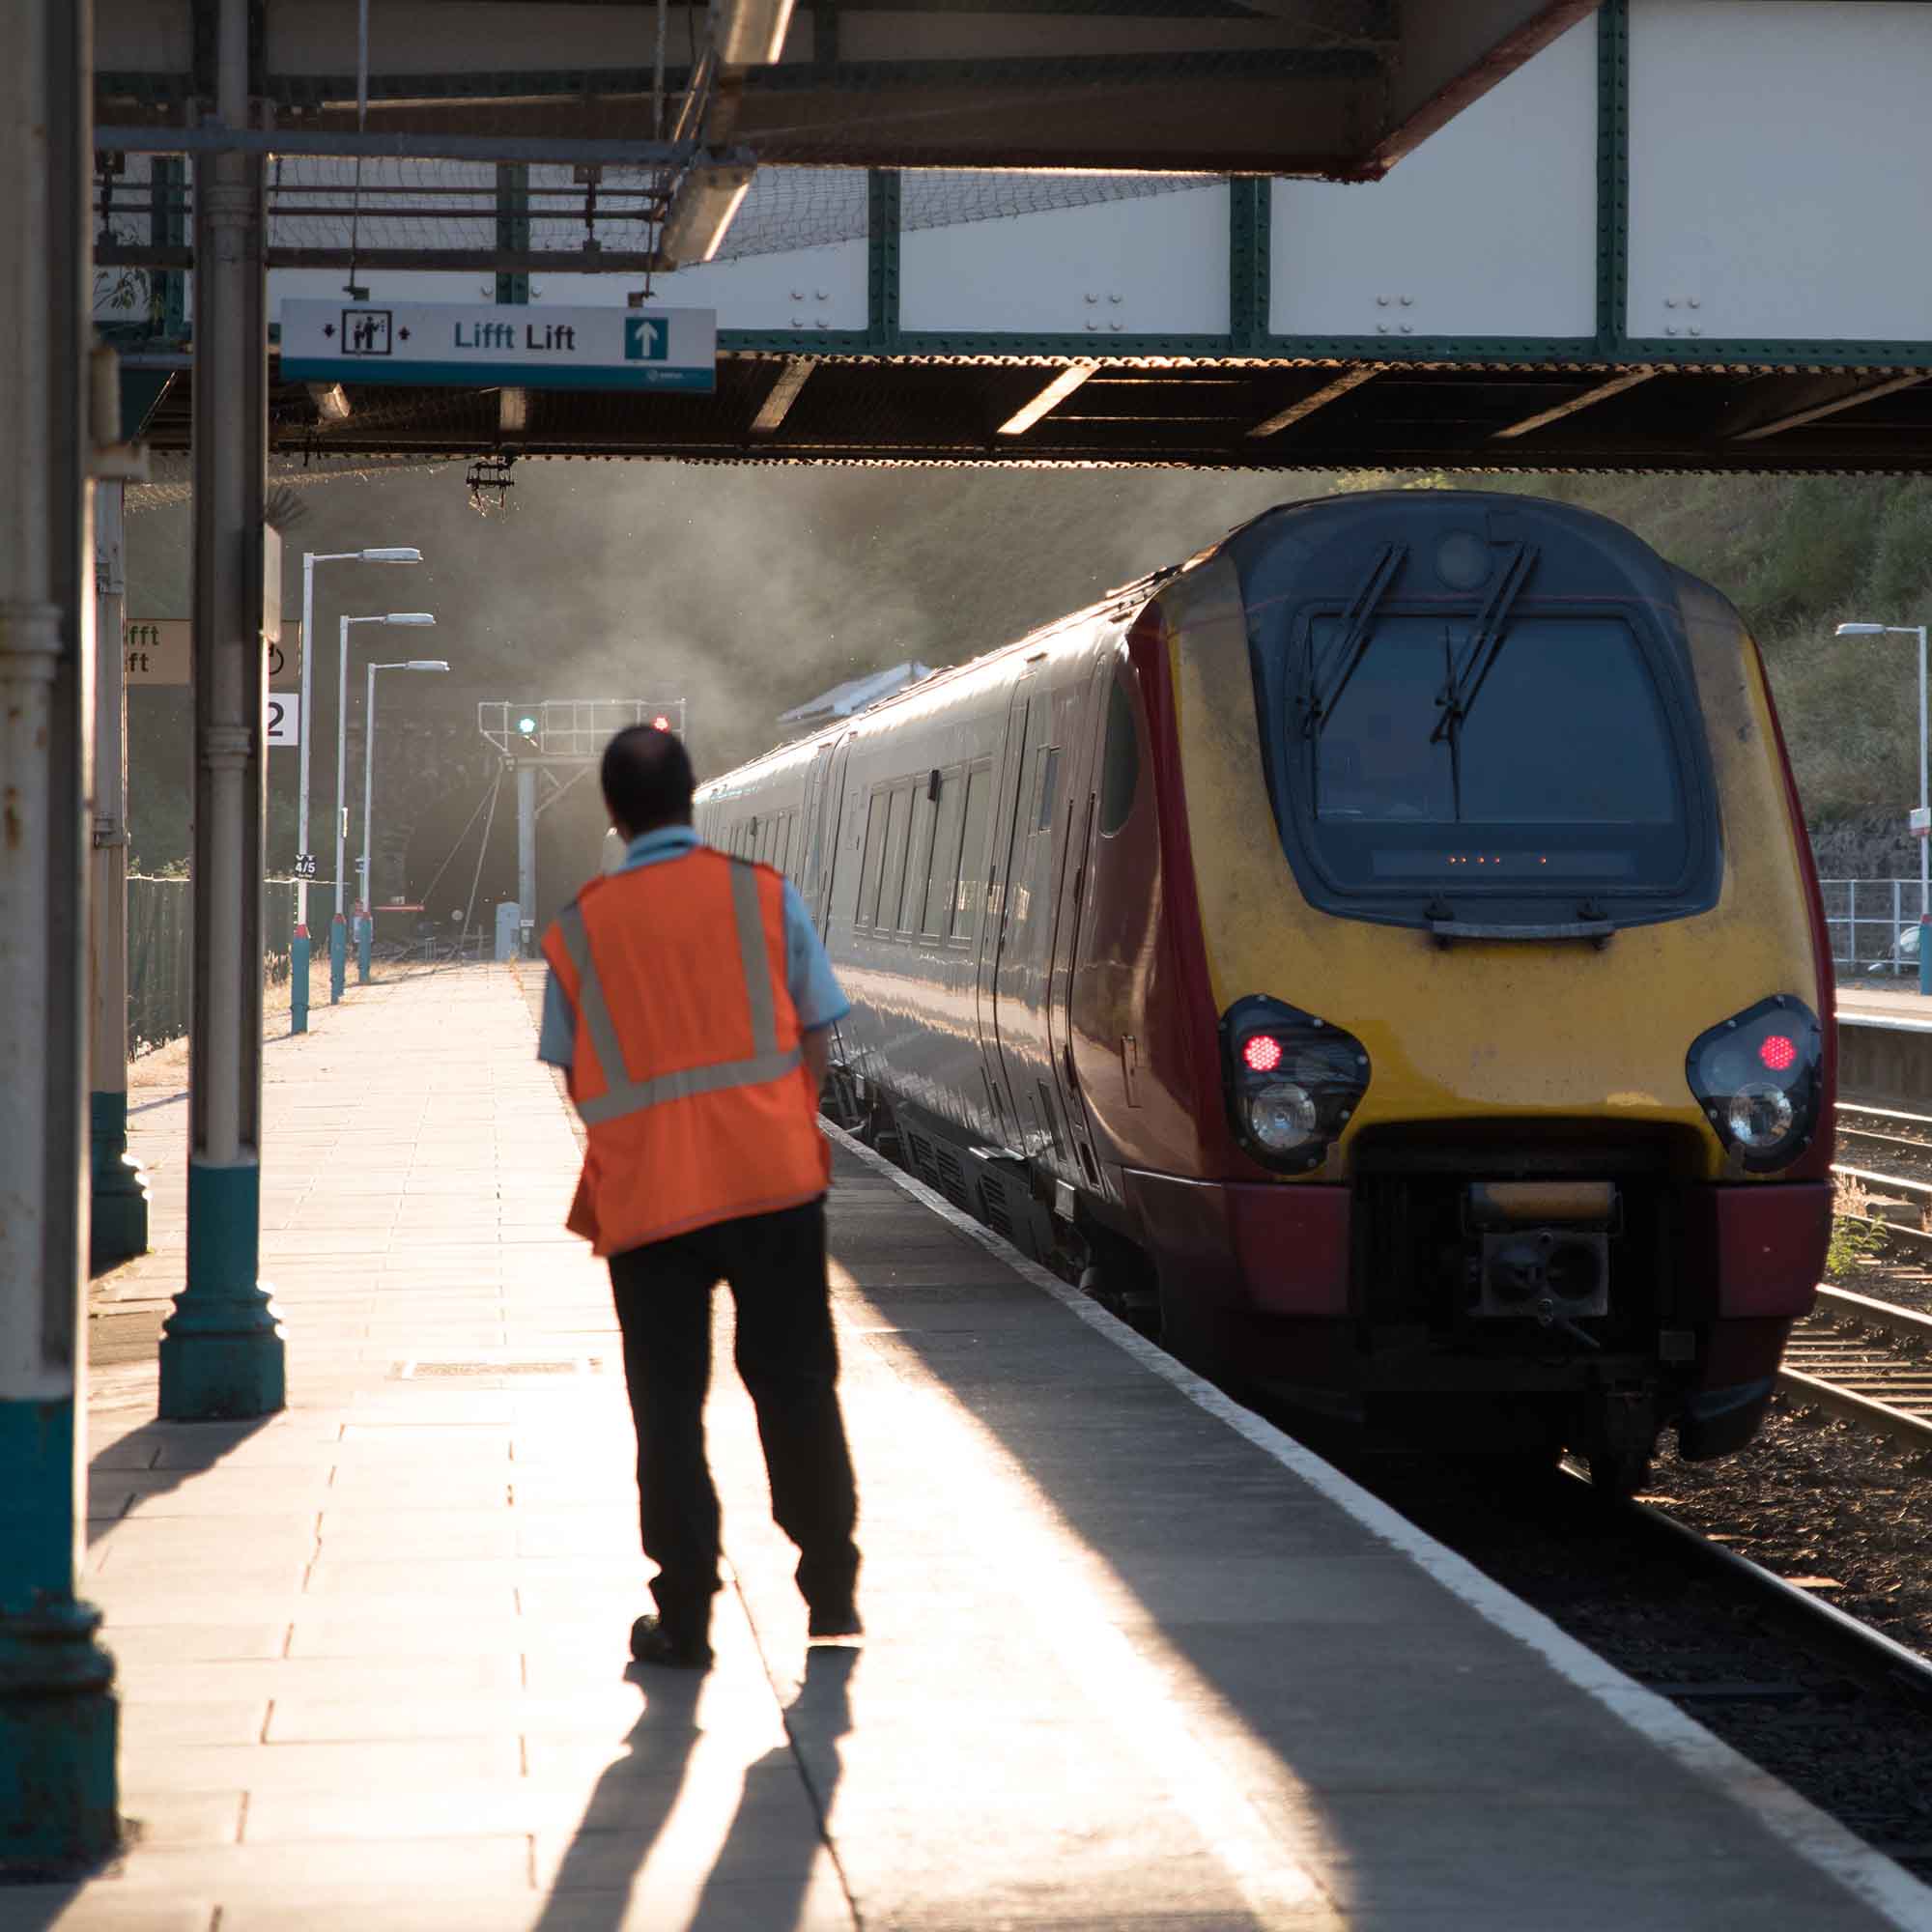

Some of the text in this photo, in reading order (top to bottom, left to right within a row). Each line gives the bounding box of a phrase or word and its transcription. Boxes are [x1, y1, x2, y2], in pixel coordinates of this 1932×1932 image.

[455, 322, 576, 351] Lifft Lift
[295, 862, 316, 873] 4/5
